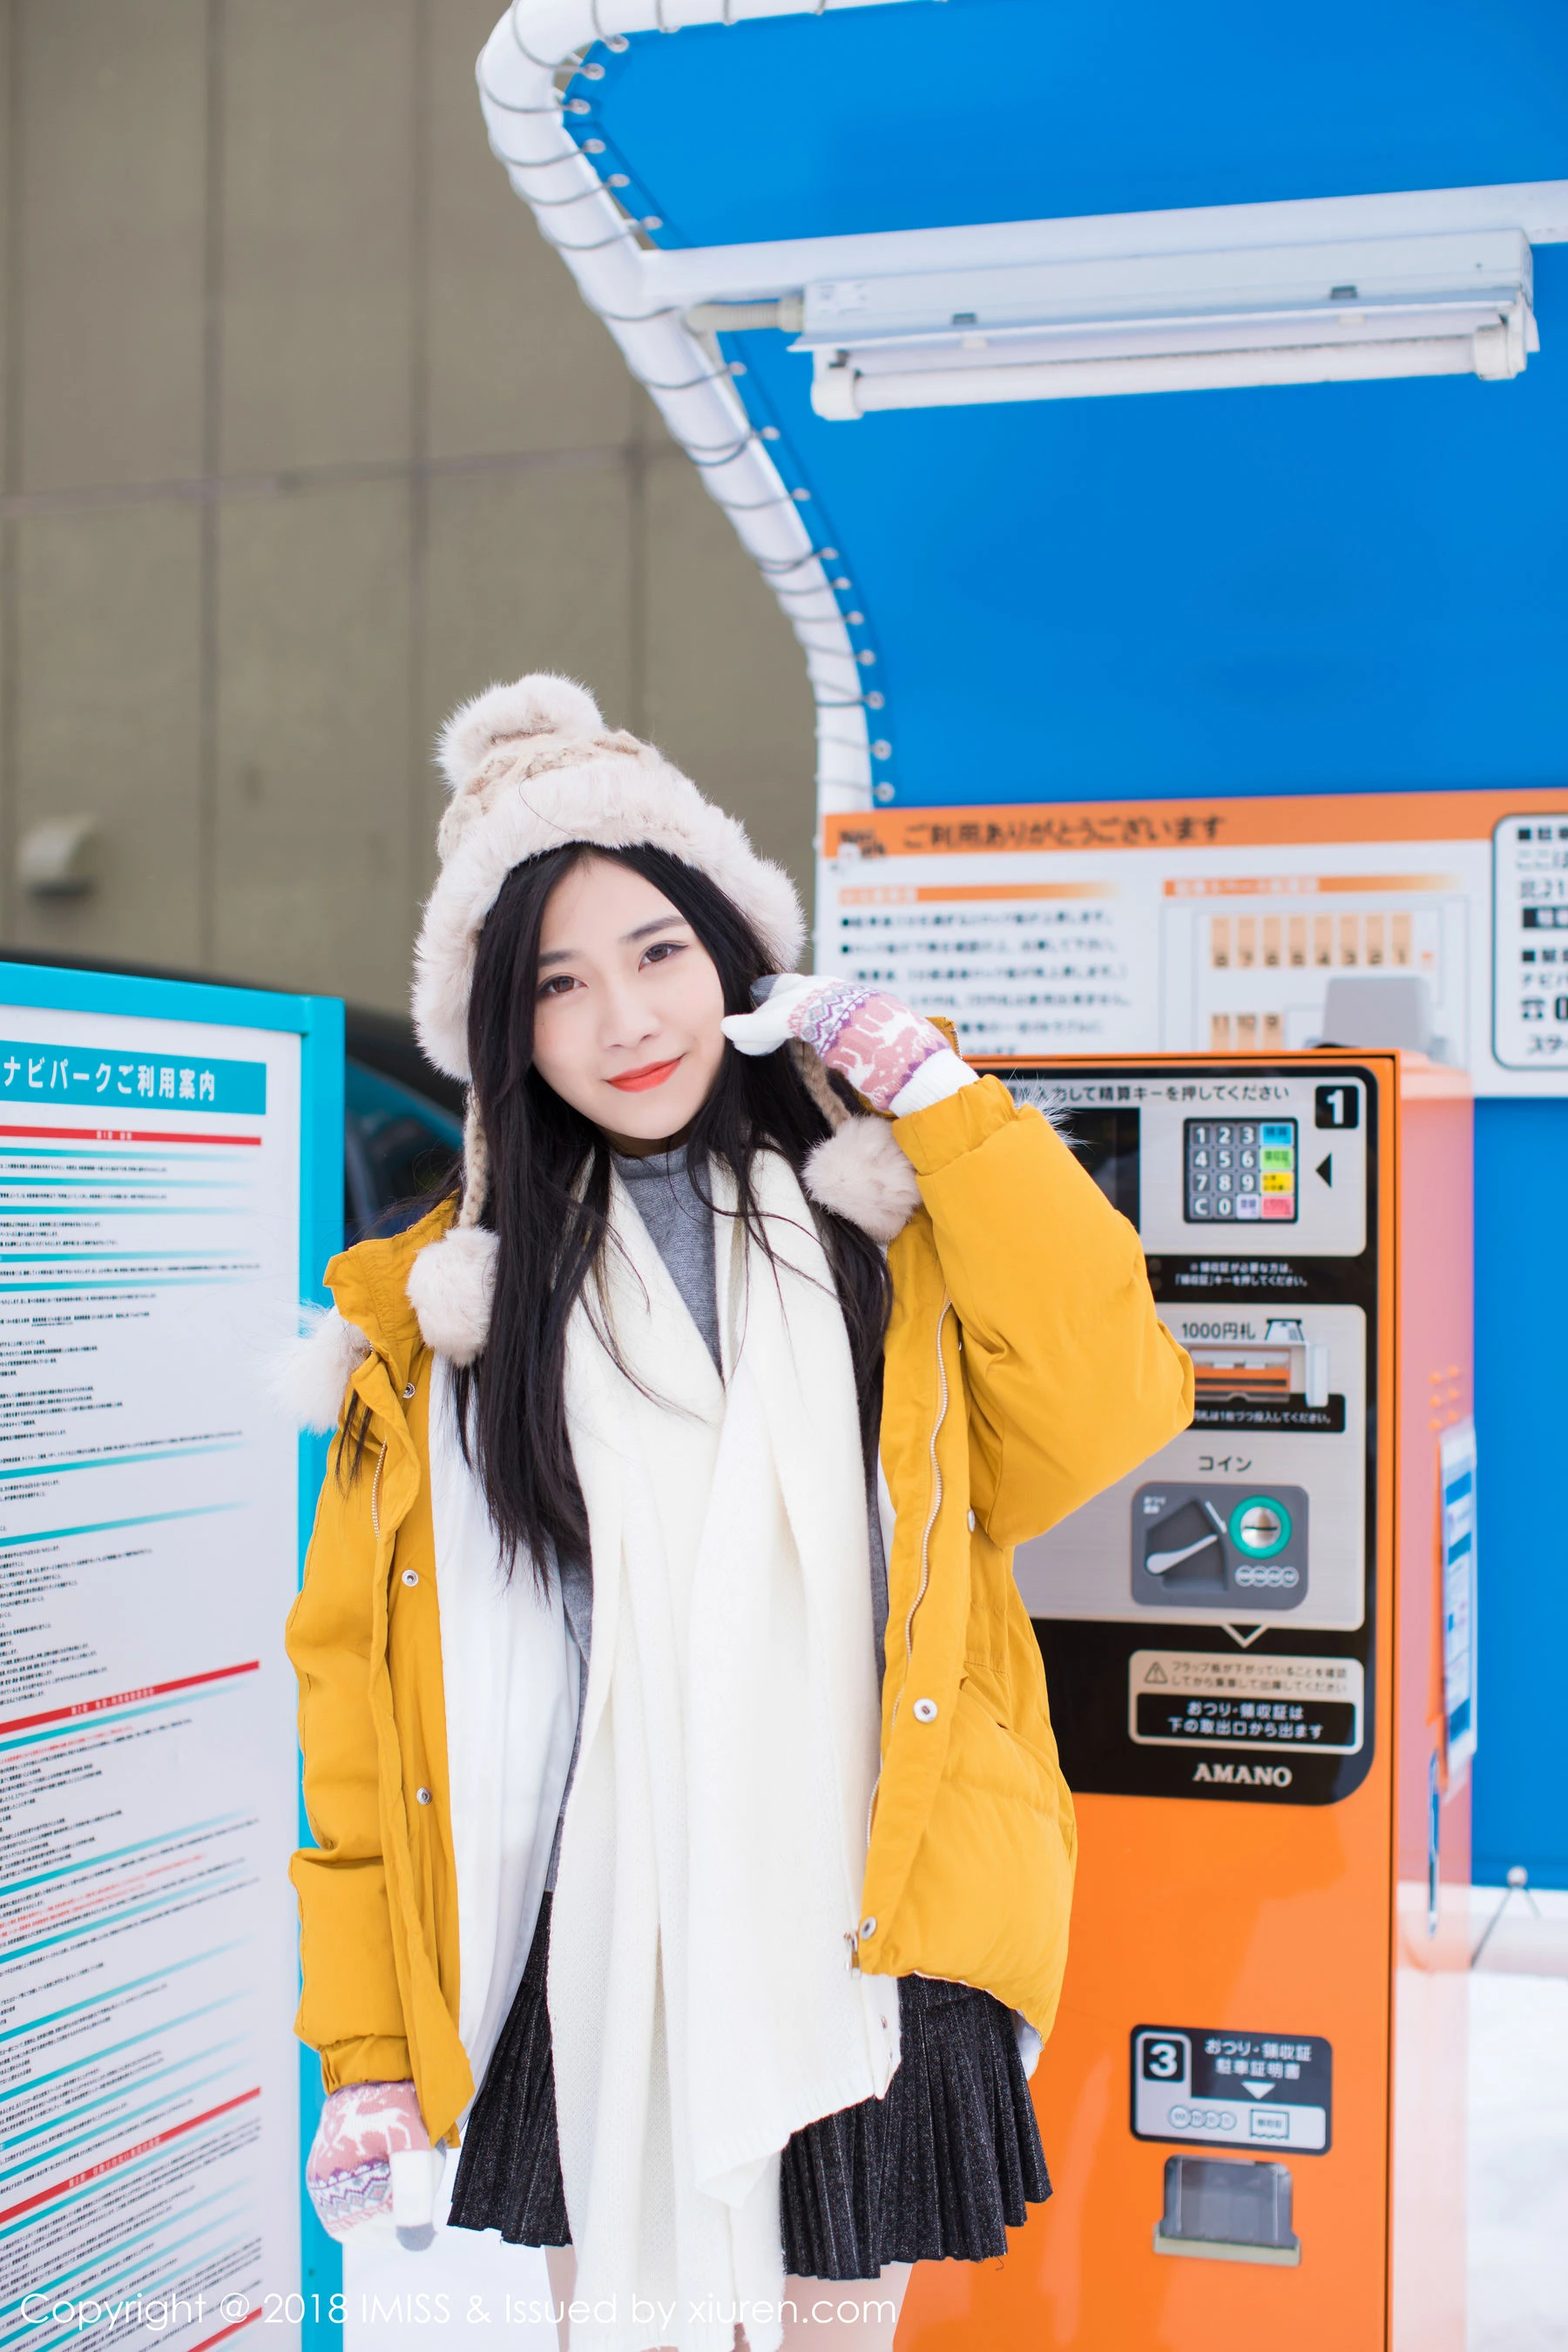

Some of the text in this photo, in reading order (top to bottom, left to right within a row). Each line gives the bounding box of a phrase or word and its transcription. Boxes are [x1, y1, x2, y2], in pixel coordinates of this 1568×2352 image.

[902, 815, 1226, 848] ご利用ありがとうございます
[3, 1056, 215, 1102] ナビパークご利用案内
[1327, 1089, 1345, 1125] 1
[1196, 1126, 1206, 1145] 1
[1219, 1126, 1232, 1145] 2
[1242, 1126, 1254, 1145] 3
[1194, 1150, 1254, 1168] 4 5 6
[1196, 1173, 1207, 1192] 7
[1219, 1173, 1231, 1192] 8
[1241, 1173, 1254, 1192] 9
[1194, 1197, 1208, 1215] C
[1218, 1197, 1232, 1215] 0
[1182, 1322, 1256, 1340] 1000円札
[1199, 1456, 1252, 1472] コイン
[1187, 1700, 1304, 1720] おつり・領収証は
[1167, 1716, 1323, 1740] 下の取出口から出ます
[1193, 1761, 1293, 1788] AMANO
[1149, 2042, 1178, 2078] 3
[1205, 2038, 1312, 2062] おつり・領収証
[1215, 2057, 1301, 2080] 駐車証明書
